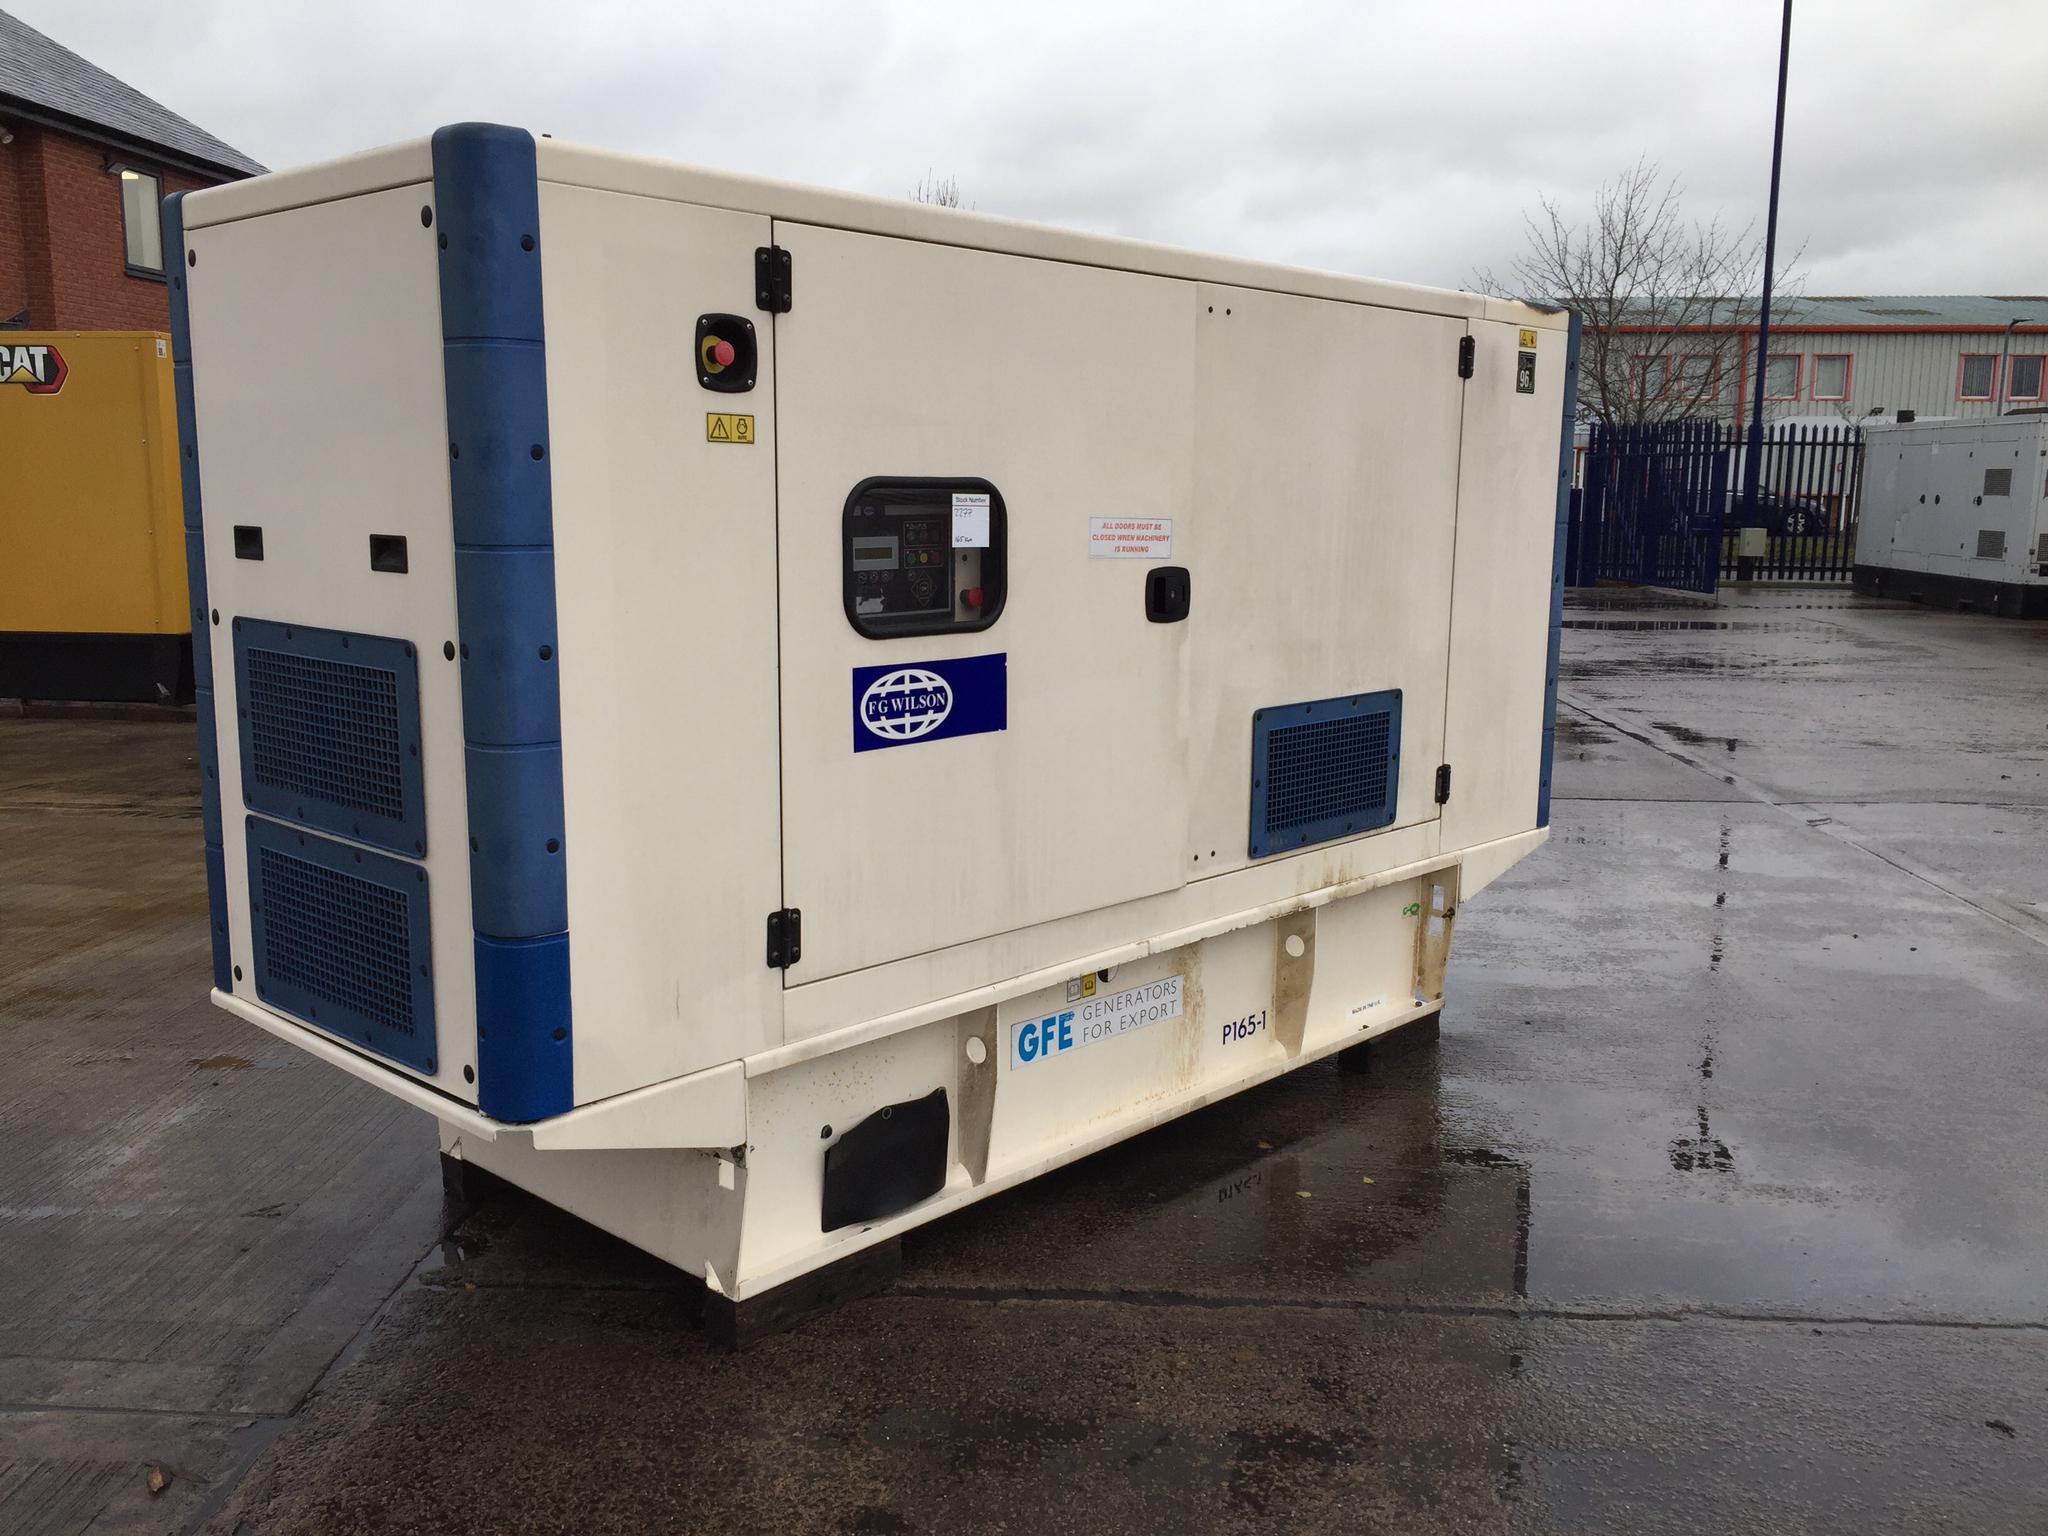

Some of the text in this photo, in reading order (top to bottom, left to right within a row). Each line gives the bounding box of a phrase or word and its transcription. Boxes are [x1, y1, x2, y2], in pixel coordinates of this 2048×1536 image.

[0, 346, 48, 383] CAT
[1519, 370, 1529, 387] 96
[1102, 522, 1114, 530] ALL
[1115, 522, 1135, 530] DOORS
[1154, 523, 1162, 531] BE
[1114, 545, 1150, 553] IS RUNNING
[891, 692, 946, 712] WILSON
[1018, 979, 1178, 1062] GFE GENERATORS
[1083, 999, 1178, 1043] FOR EXPORT
[1222, 1010, 1267, 1046] P165-1
